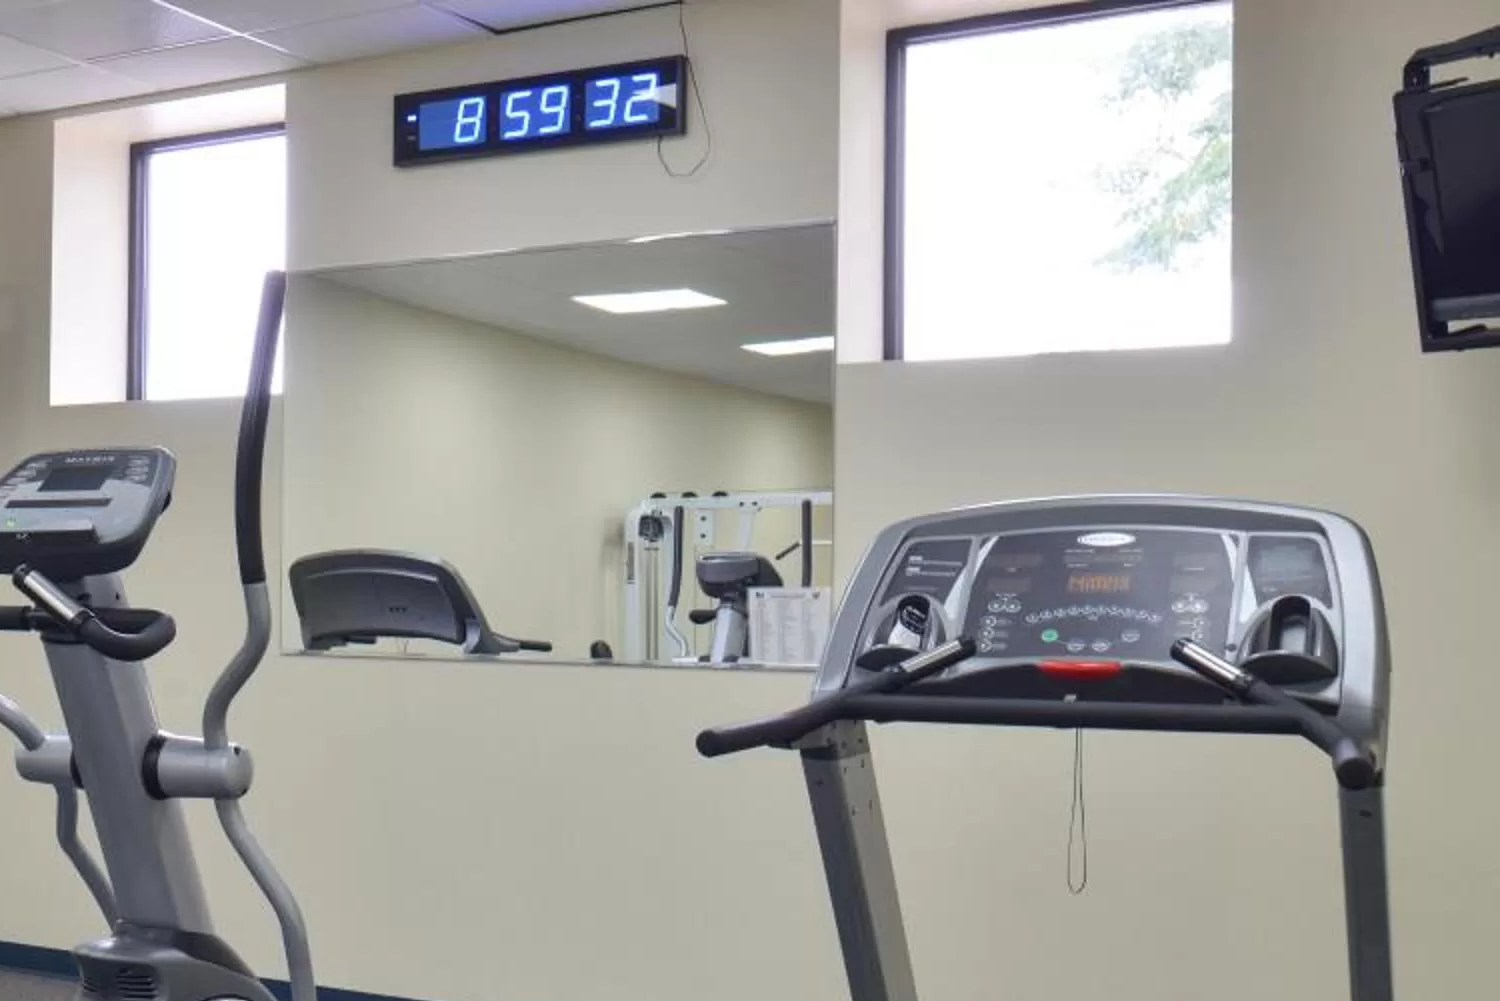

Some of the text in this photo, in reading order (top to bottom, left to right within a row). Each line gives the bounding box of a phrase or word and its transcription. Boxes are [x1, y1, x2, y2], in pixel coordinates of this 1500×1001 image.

[453, 72, 658, 144] 8 59 32
